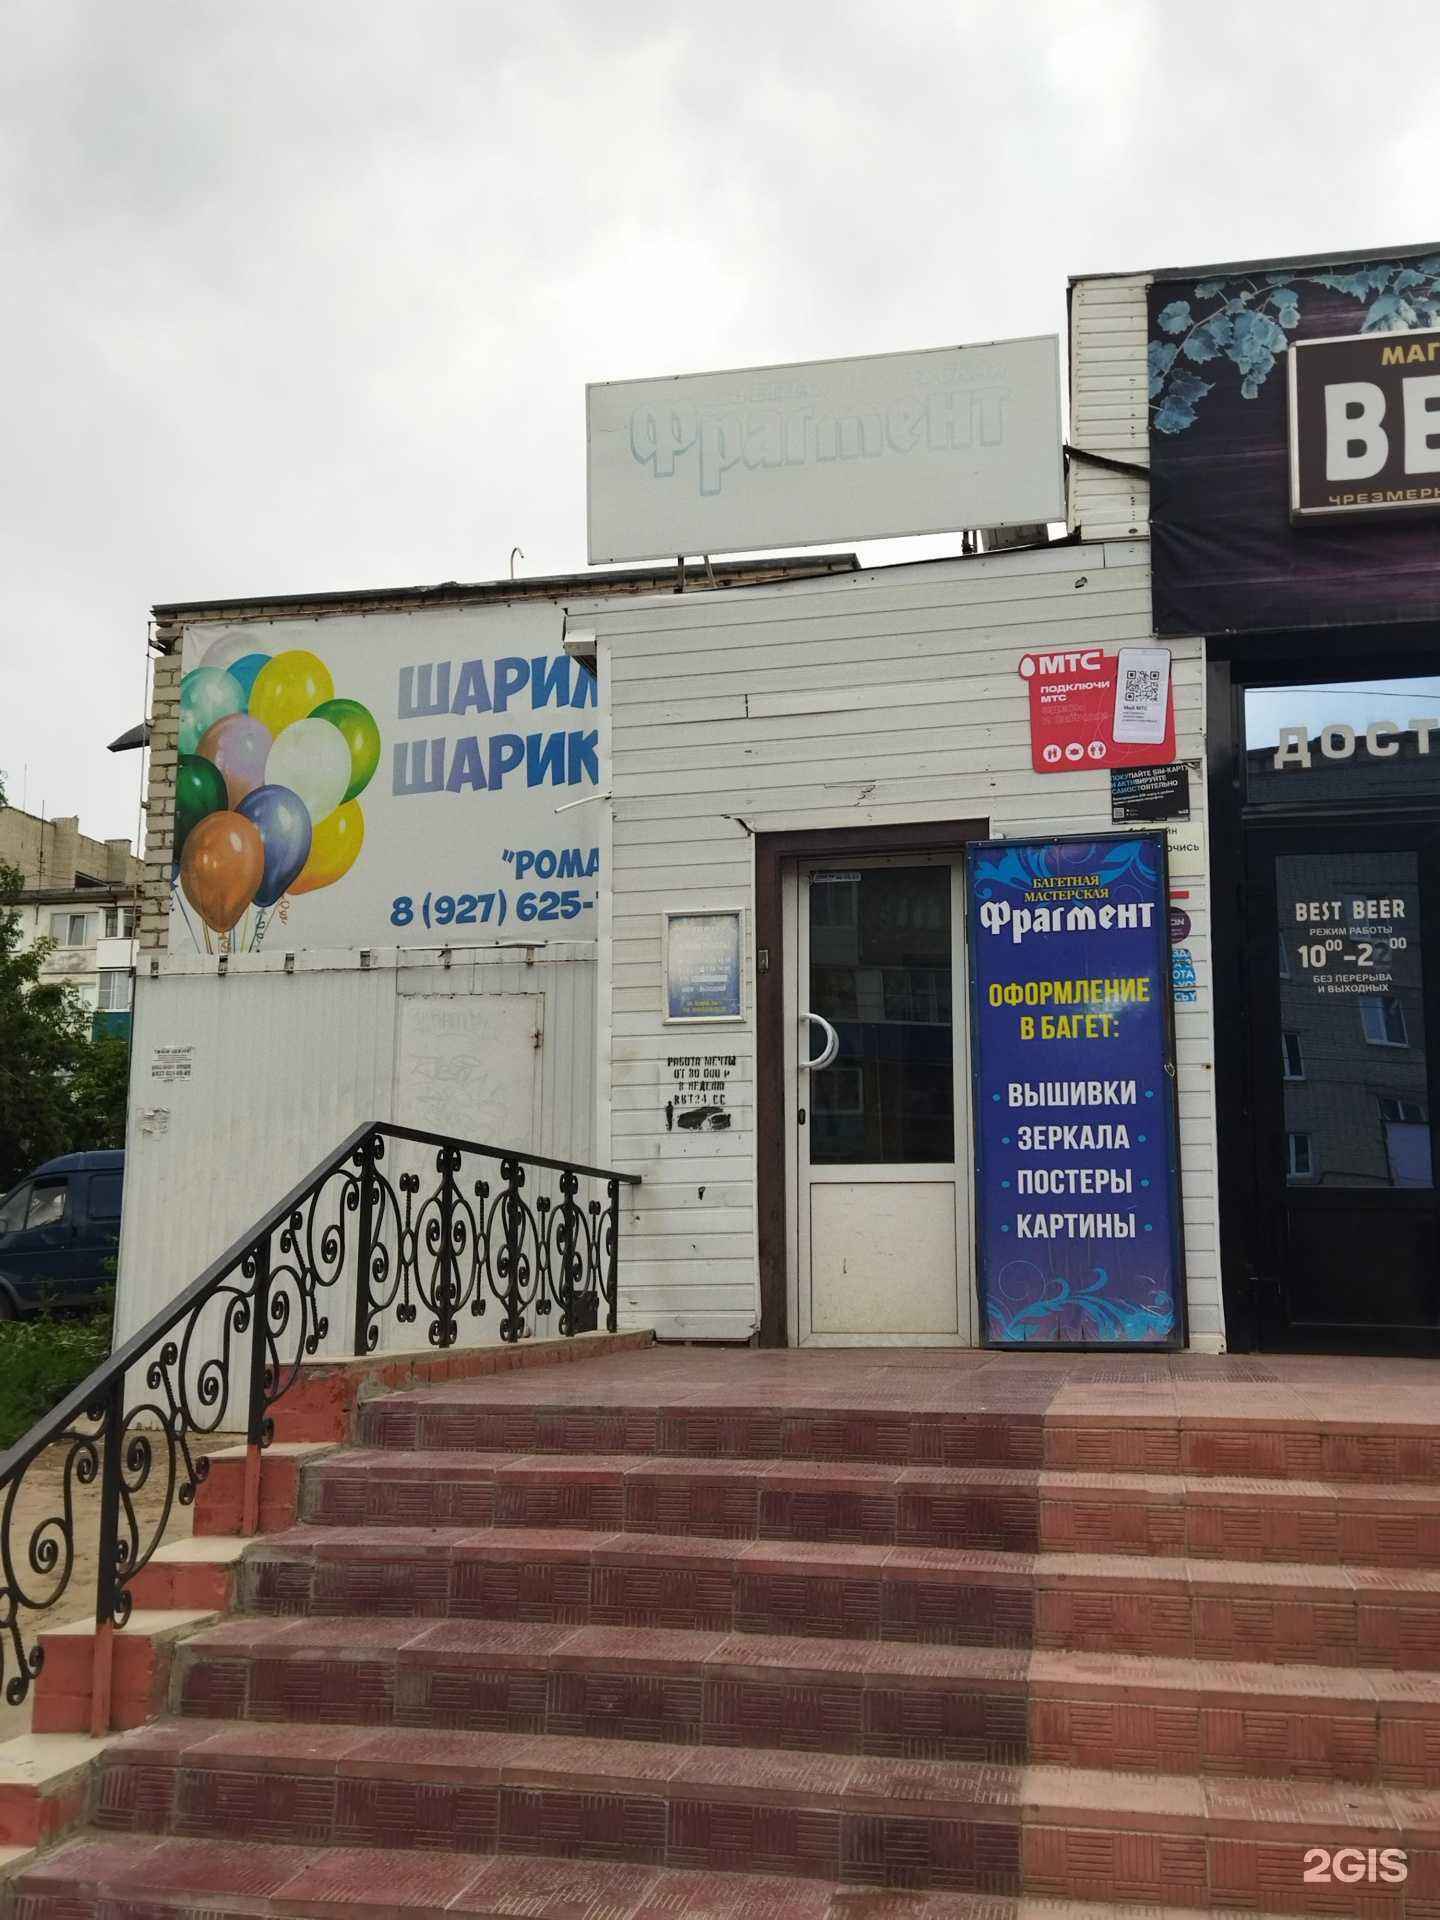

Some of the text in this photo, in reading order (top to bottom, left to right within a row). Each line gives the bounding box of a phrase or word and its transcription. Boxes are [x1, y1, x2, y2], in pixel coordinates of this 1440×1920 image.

[629, 384, 1012, 496] Фрагмент
[1324, 374, 1440, 482] BE
[1039, 652, 1101, 675] МТС
[1040, 694, 1067, 703] МТС
[1274, 718, 1439, 769] ДОСТ
[392, 729, 599, 796] ШАРИК
[1033, 874, 1099, 888] БАГЕТНАЯ
[1024, 888, 1109, 902] МАСТЕРСКАЯ
[389, 896, 414, 926] 8
[422, 889, 507, 929] (927)
[980, 900, 1155, 944] Фрагмент
[1295, 899, 1405, 921] BEST BEER
[1310, 926, 1393, 936] РЕЖИМ РАБОТЫ
[1313, 973, 1393, 983] БЕЗ ПЕРЕРЫВА
[1318, 983, 1389, 993] И ВЫХОДНЫХ
[988, 977, 1150, 1007] ОФОРМЛЕНИЕ
[1020, 1014, 1119, 1040] В БАГЕТ:
[1008, 1080, 1137, 1107] ВЫШИВКИ
[1017, 1124, 1131, 1150] ЗЕРКАЛА
[1017, 1168, 1133, 1194] ПОСТЕРЫ
[1017, 1213, 1136, 1238] КАРТИНЫ
